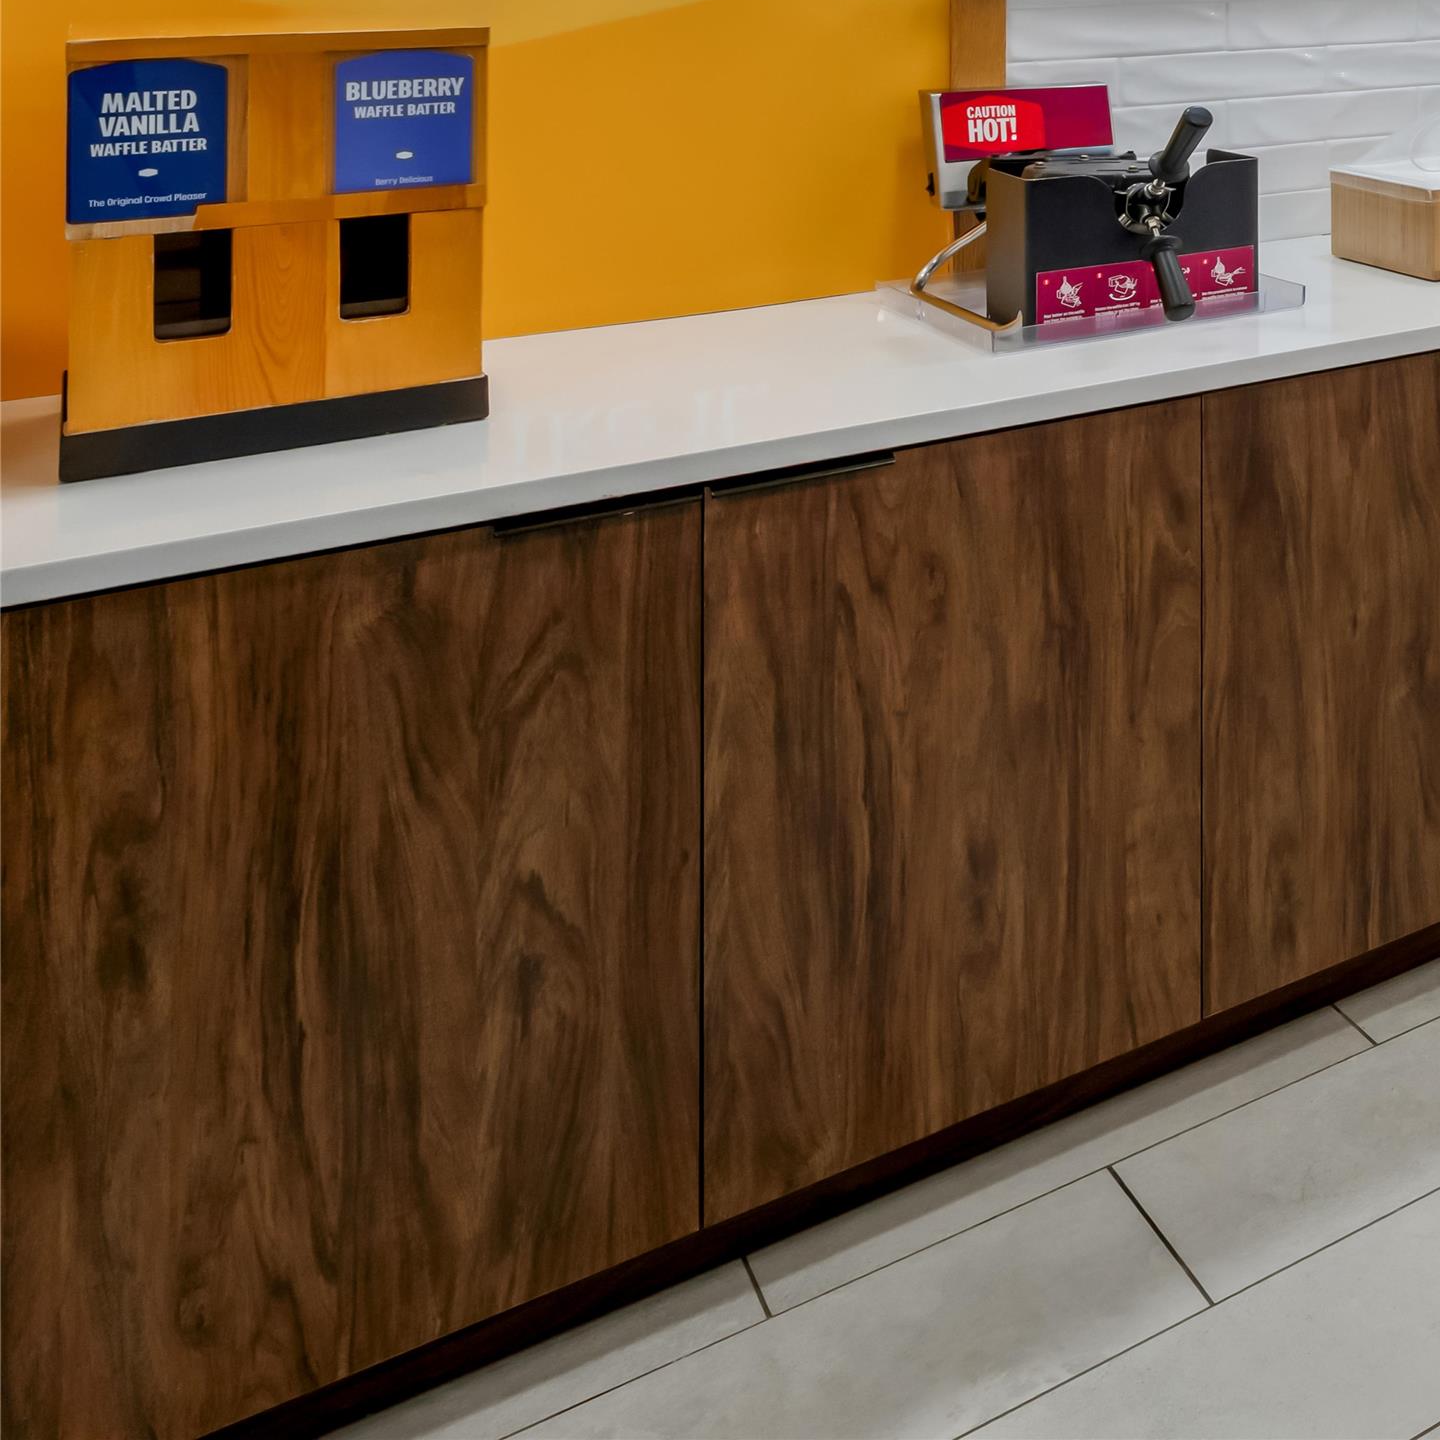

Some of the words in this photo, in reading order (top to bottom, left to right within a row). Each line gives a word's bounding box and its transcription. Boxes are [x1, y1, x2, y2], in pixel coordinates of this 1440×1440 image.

[346, 77, 465, 101] BLUEBERRY
[101, 89, 197, 113] MALTED
[354, 104, 404, 119] WAFFLE
[407, 101, 456, 116] BATTER
[966, 105, 1016, 119] CAUTION
[98, 112, 200, 137] VANILLA
[967, 117, 1018, 143] HOT!
[90, 141, 147, 158] WAFFLE
[152, 138, 207, 154] BATTER
[375, 177, 398, 186] Berry
[88, 199, 105, 208] The
[107, 196, 142, 207] Original
[144, 193, 172, 204] Crowd
[174, 191, 207, 201] Pleaser
